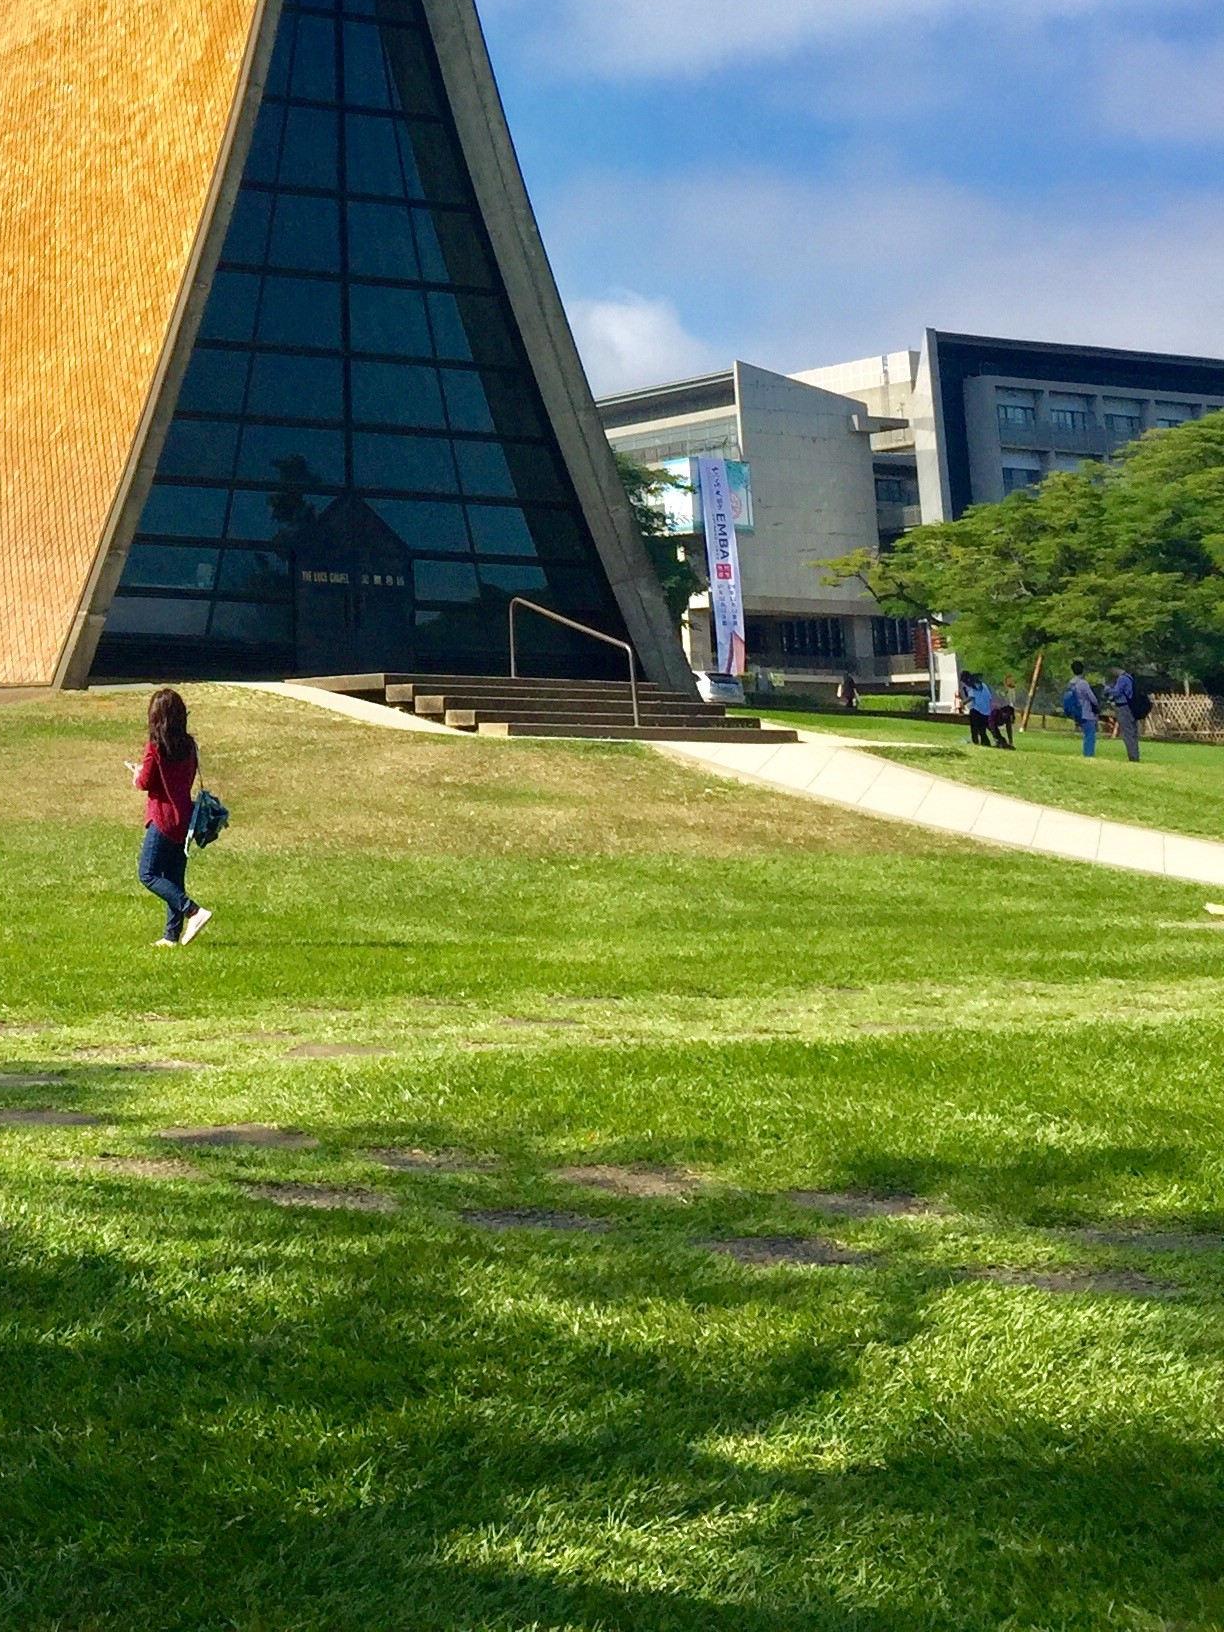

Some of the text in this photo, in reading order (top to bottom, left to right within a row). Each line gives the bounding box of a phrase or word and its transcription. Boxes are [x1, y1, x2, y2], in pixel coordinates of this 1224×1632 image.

[716, 513, 730, 560] EMBA
[301, 571, 350, 584] THE LUCE CHAPEL
